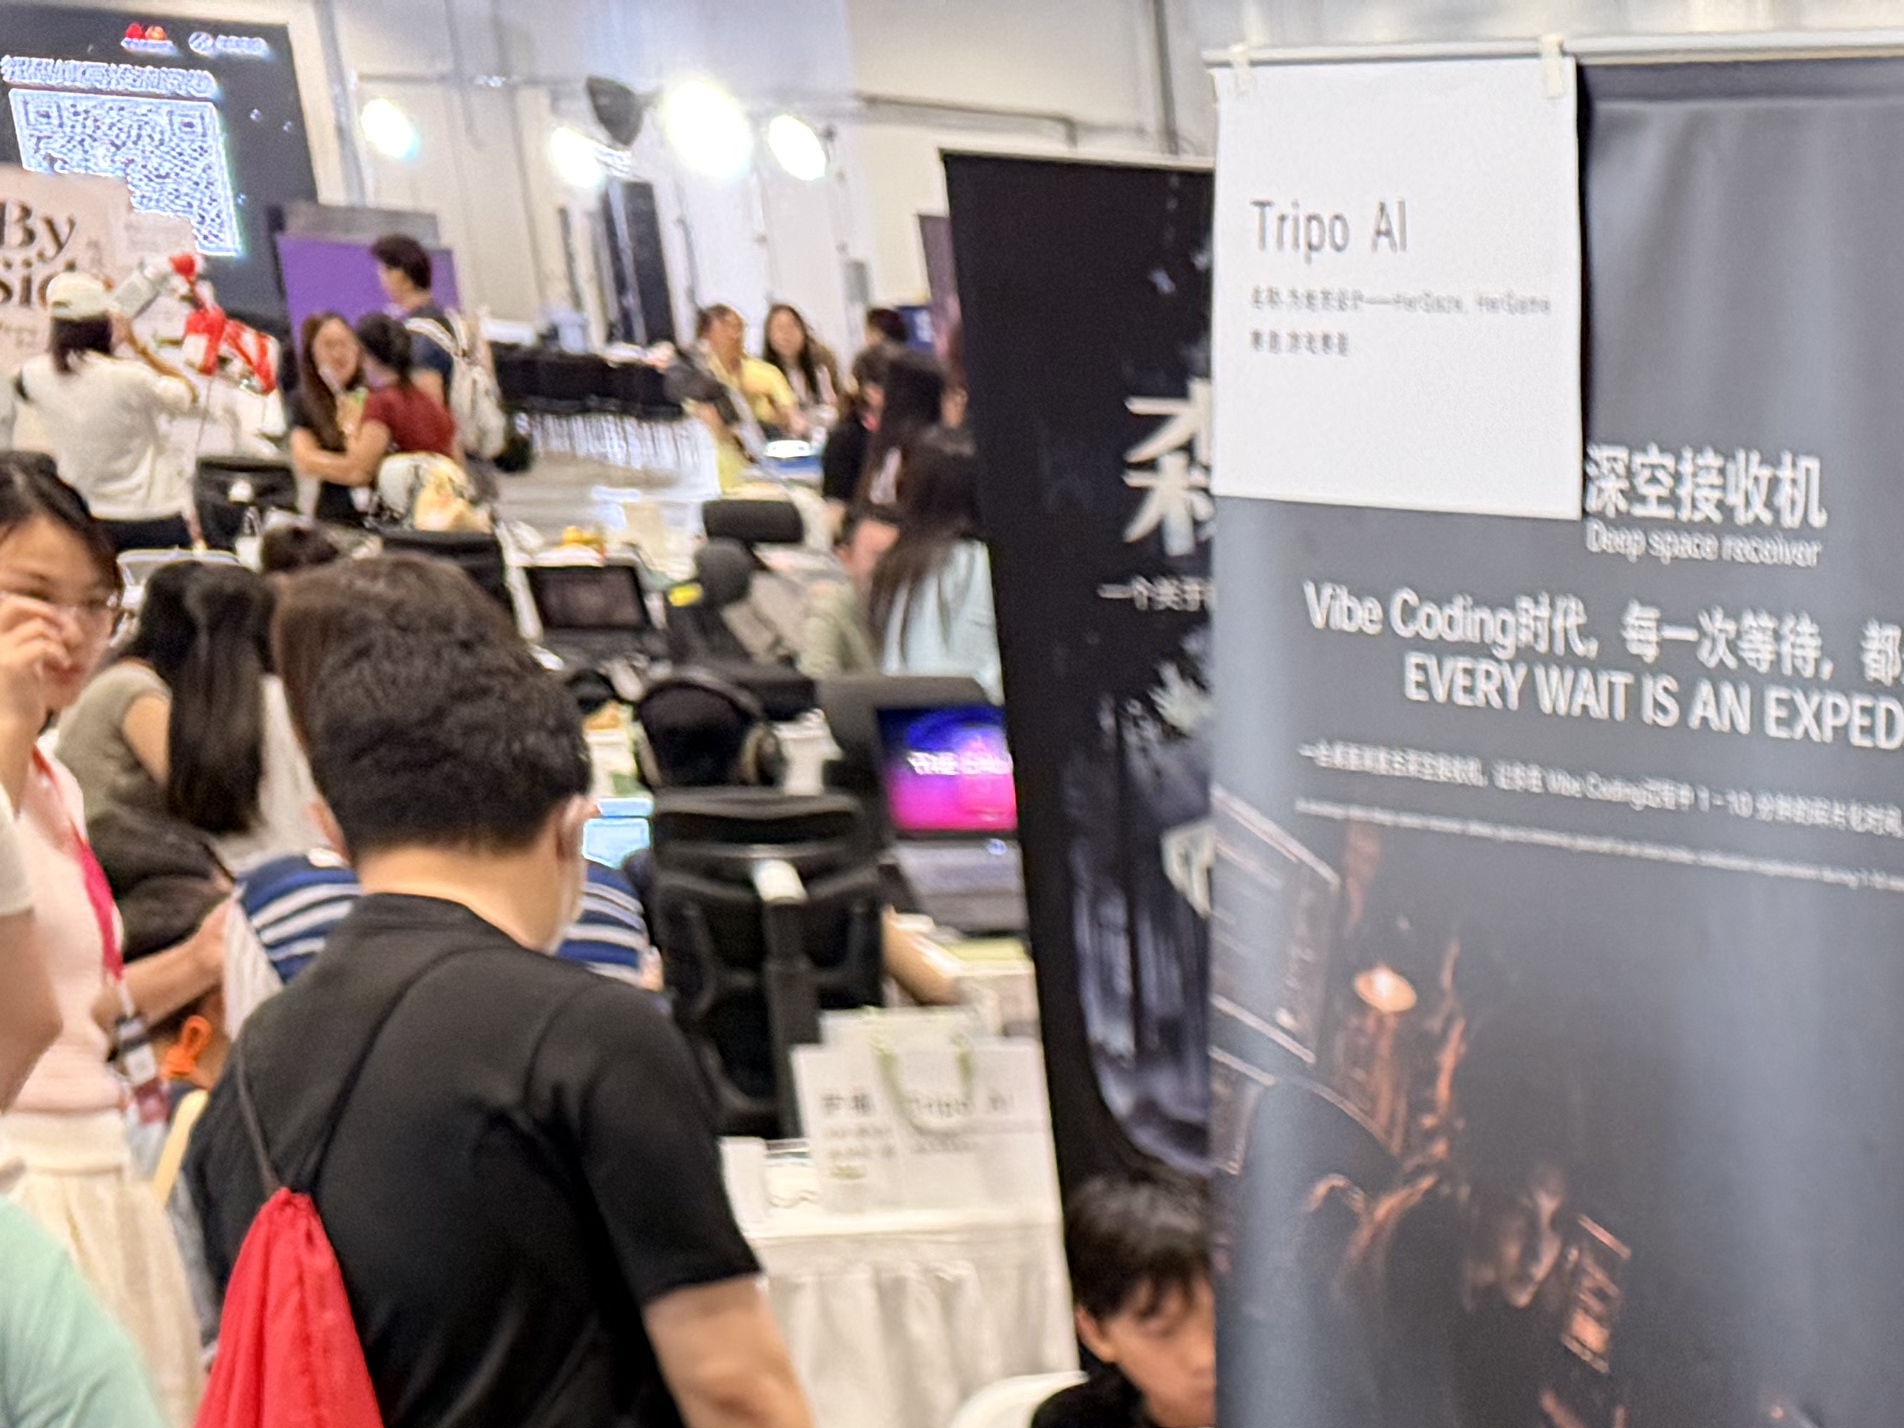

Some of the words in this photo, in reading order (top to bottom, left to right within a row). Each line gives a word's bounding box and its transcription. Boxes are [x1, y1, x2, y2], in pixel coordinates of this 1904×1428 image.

[1250, 199, 1350, 264] Tripo
[1371, 199, 1408, 252] AI
[1584, 442, 1828, 529] 深空接收机
[1585, 517, 1647, 563] Deep
[1647, 529, 1719, 565] space
[1720, 531, 1822, 567] receiver
[1302, 580, 1383, 635] Vibe
[1404, 651, 1528, 712] EVERY
[1534, 661, 1635, 722] WAIT
[1641, 671, 1681, 728] IS
[1686, 677, 1752, 736] AN
